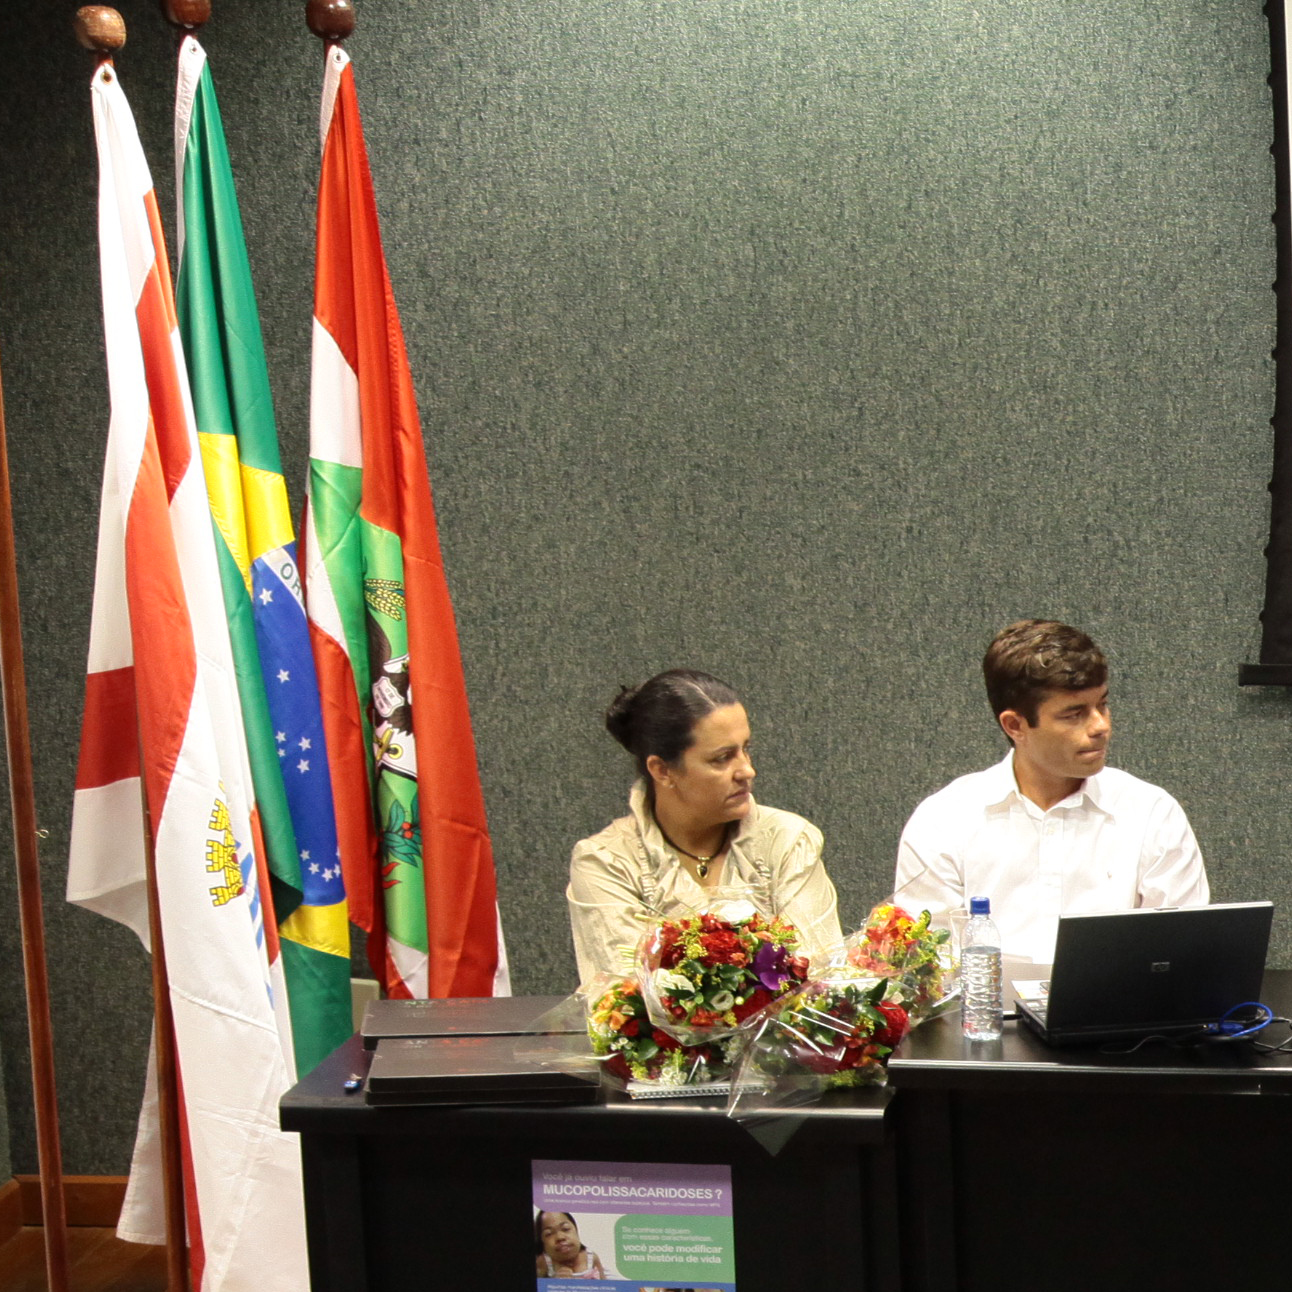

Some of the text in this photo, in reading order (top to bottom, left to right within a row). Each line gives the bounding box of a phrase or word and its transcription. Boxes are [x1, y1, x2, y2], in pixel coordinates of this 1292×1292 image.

[543, 1183, 723, 1200] MUCOPOLISSACARIDOSES ?
[623, 1243, 723, 1254] você pode modificar
[623, 1253, 722, 1264] uma história de vida
